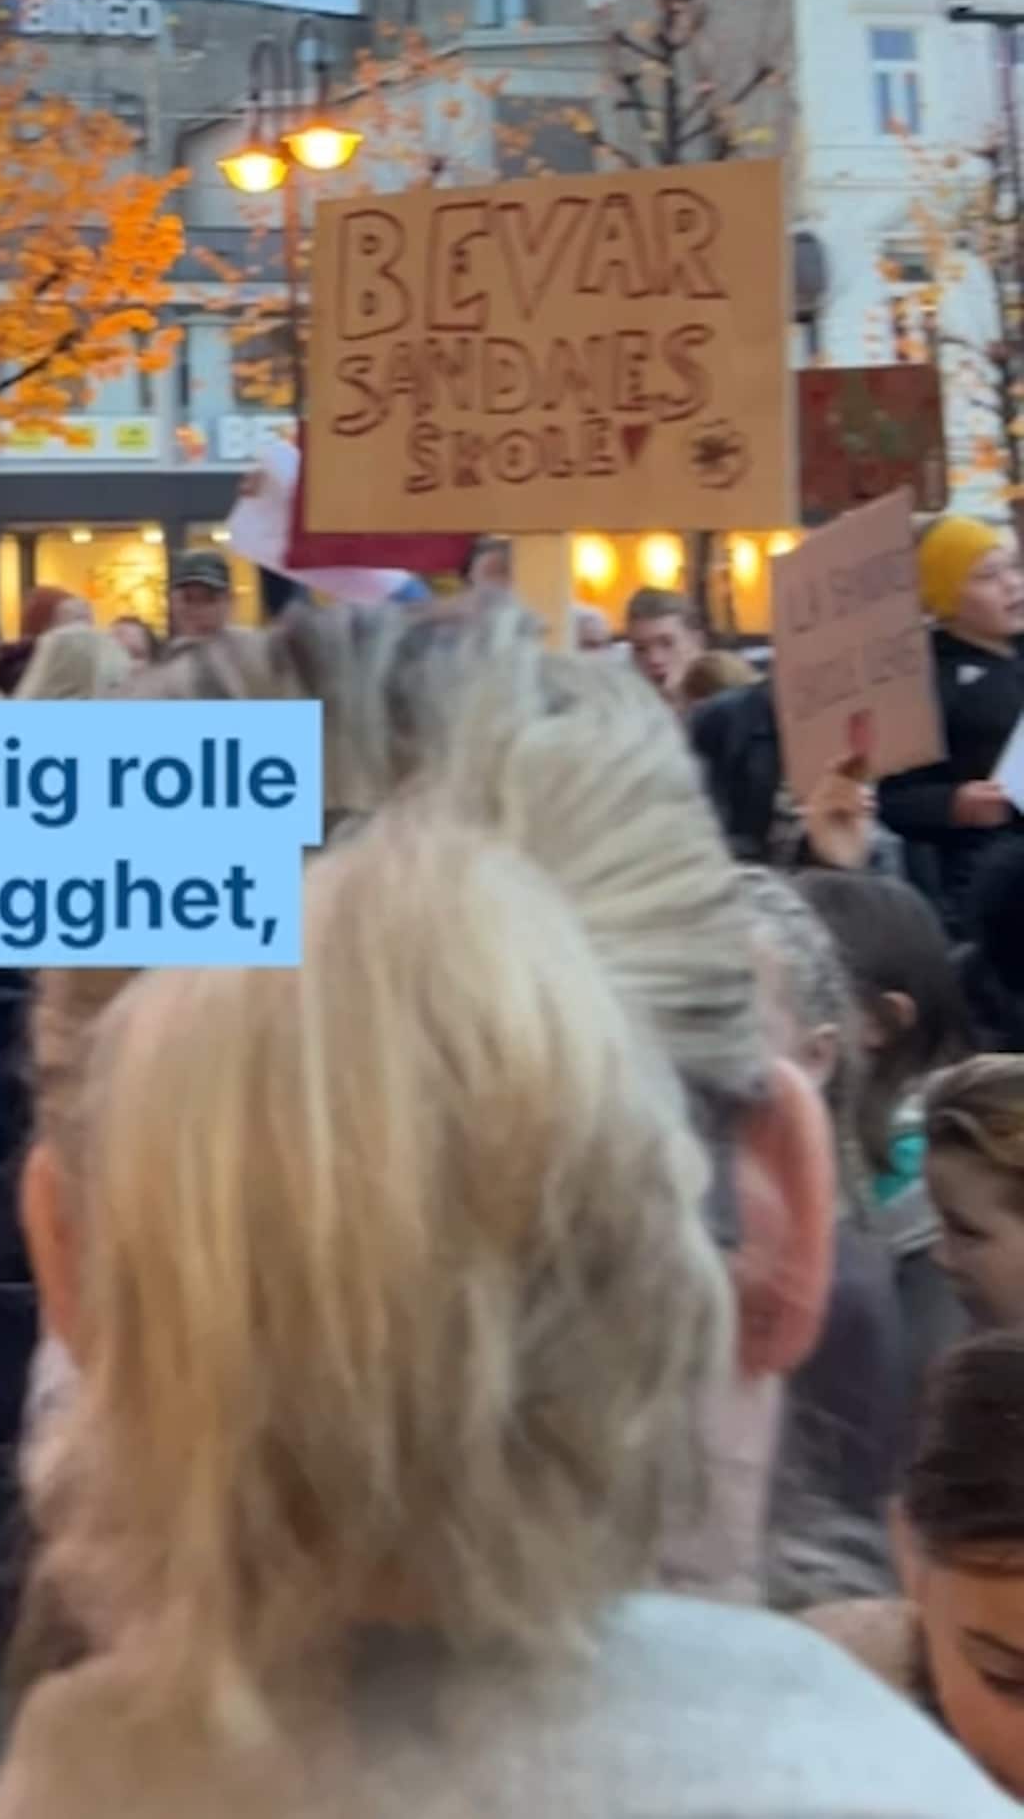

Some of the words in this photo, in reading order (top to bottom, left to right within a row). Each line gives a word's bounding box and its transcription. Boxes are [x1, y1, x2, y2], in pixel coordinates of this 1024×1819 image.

[336, 187, 729, 342] BEVAR
[331, 322, 715, 437] SANDNES
[403, 416, 618, 494] SKOLE
